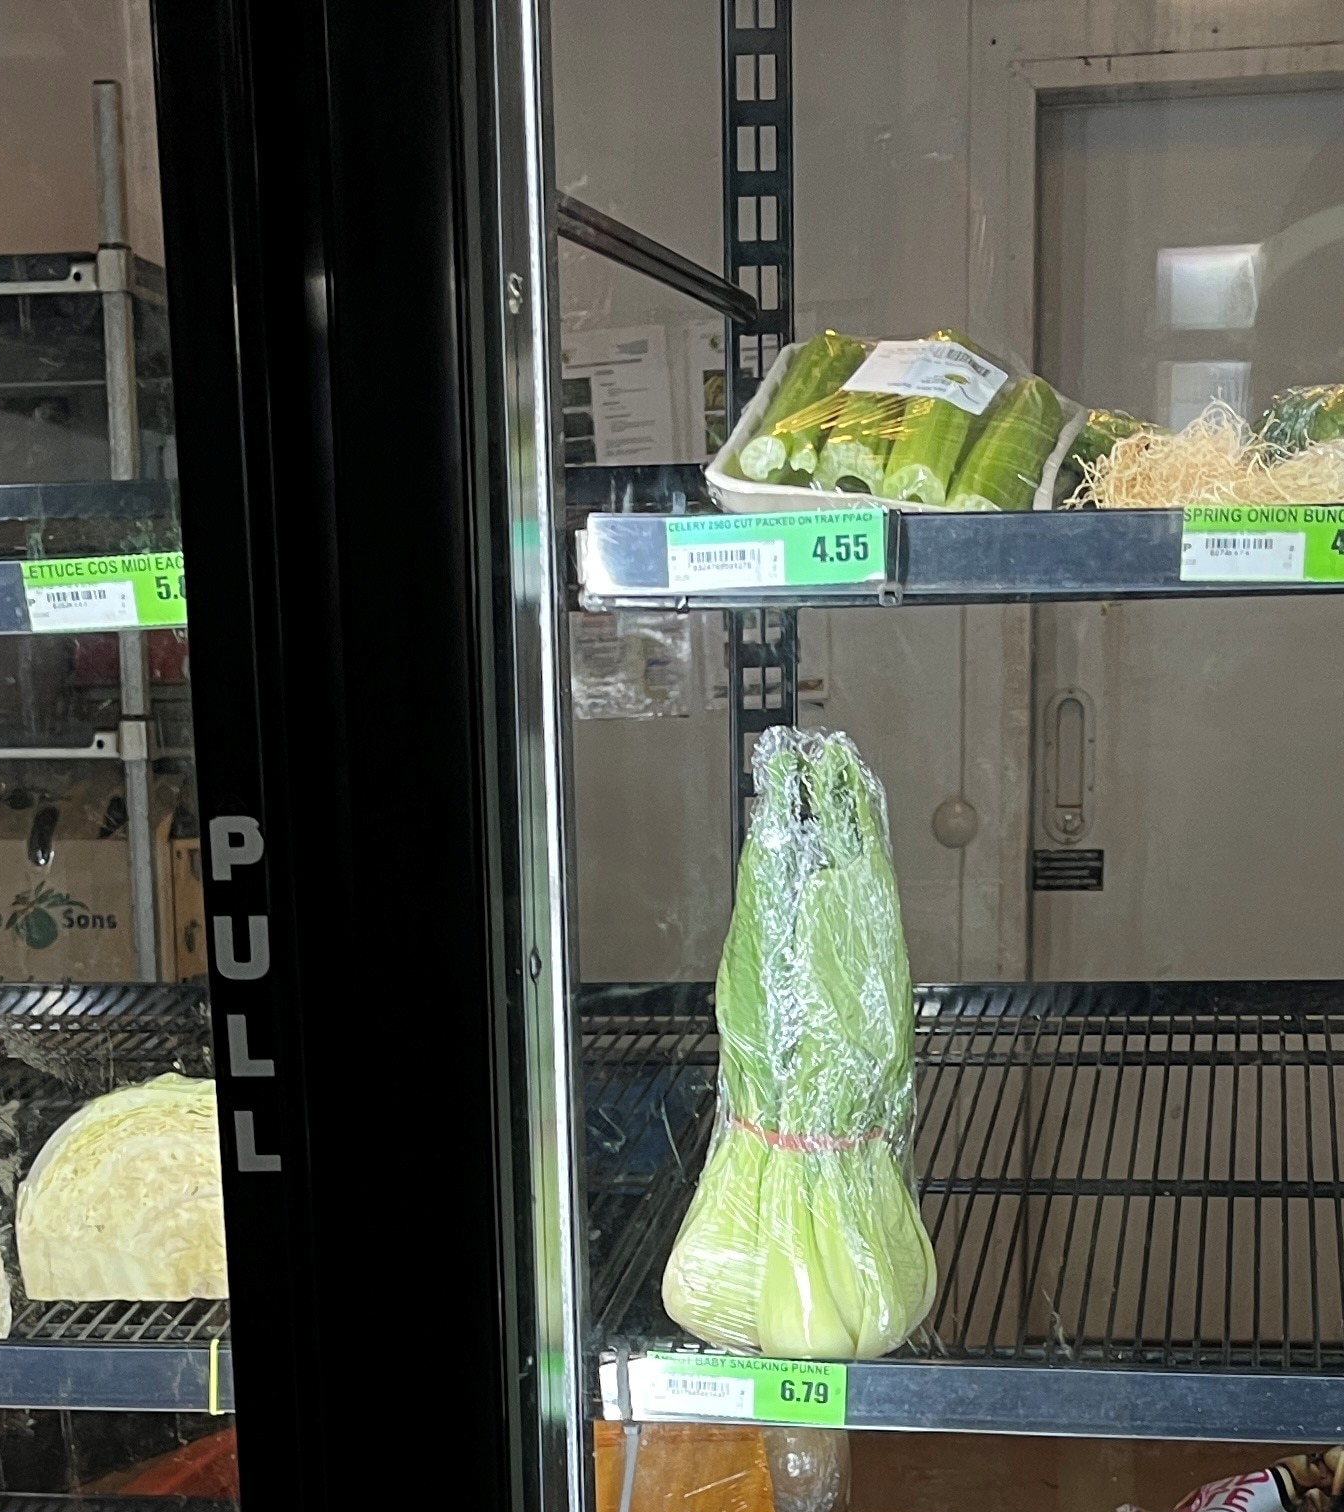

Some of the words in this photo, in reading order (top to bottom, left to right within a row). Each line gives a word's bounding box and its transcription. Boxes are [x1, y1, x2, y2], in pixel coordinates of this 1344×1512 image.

[669, 521, 705, 532] CELERY
[734, 519, 752, 529] CUT
[756, 516, 795, 527] PACKED
[799, 515, 812, 526] ON
[814, 514, 840, 524] TRAY
[1183, 508, 1243, 524] SPRING
[1247, 508, 1298, 523] ONION
[812, 533, 869, 562] 4.55
[88, 560, 118, 575] COS
[121, 557, 152, 574] MIDI
[61, 906, 118, 930] Sons
[209, 815, 282, 1172] PULL
[729, 1359, 789, 1372] SNACKING
[780, 1379, 829, 1404] 6.79
